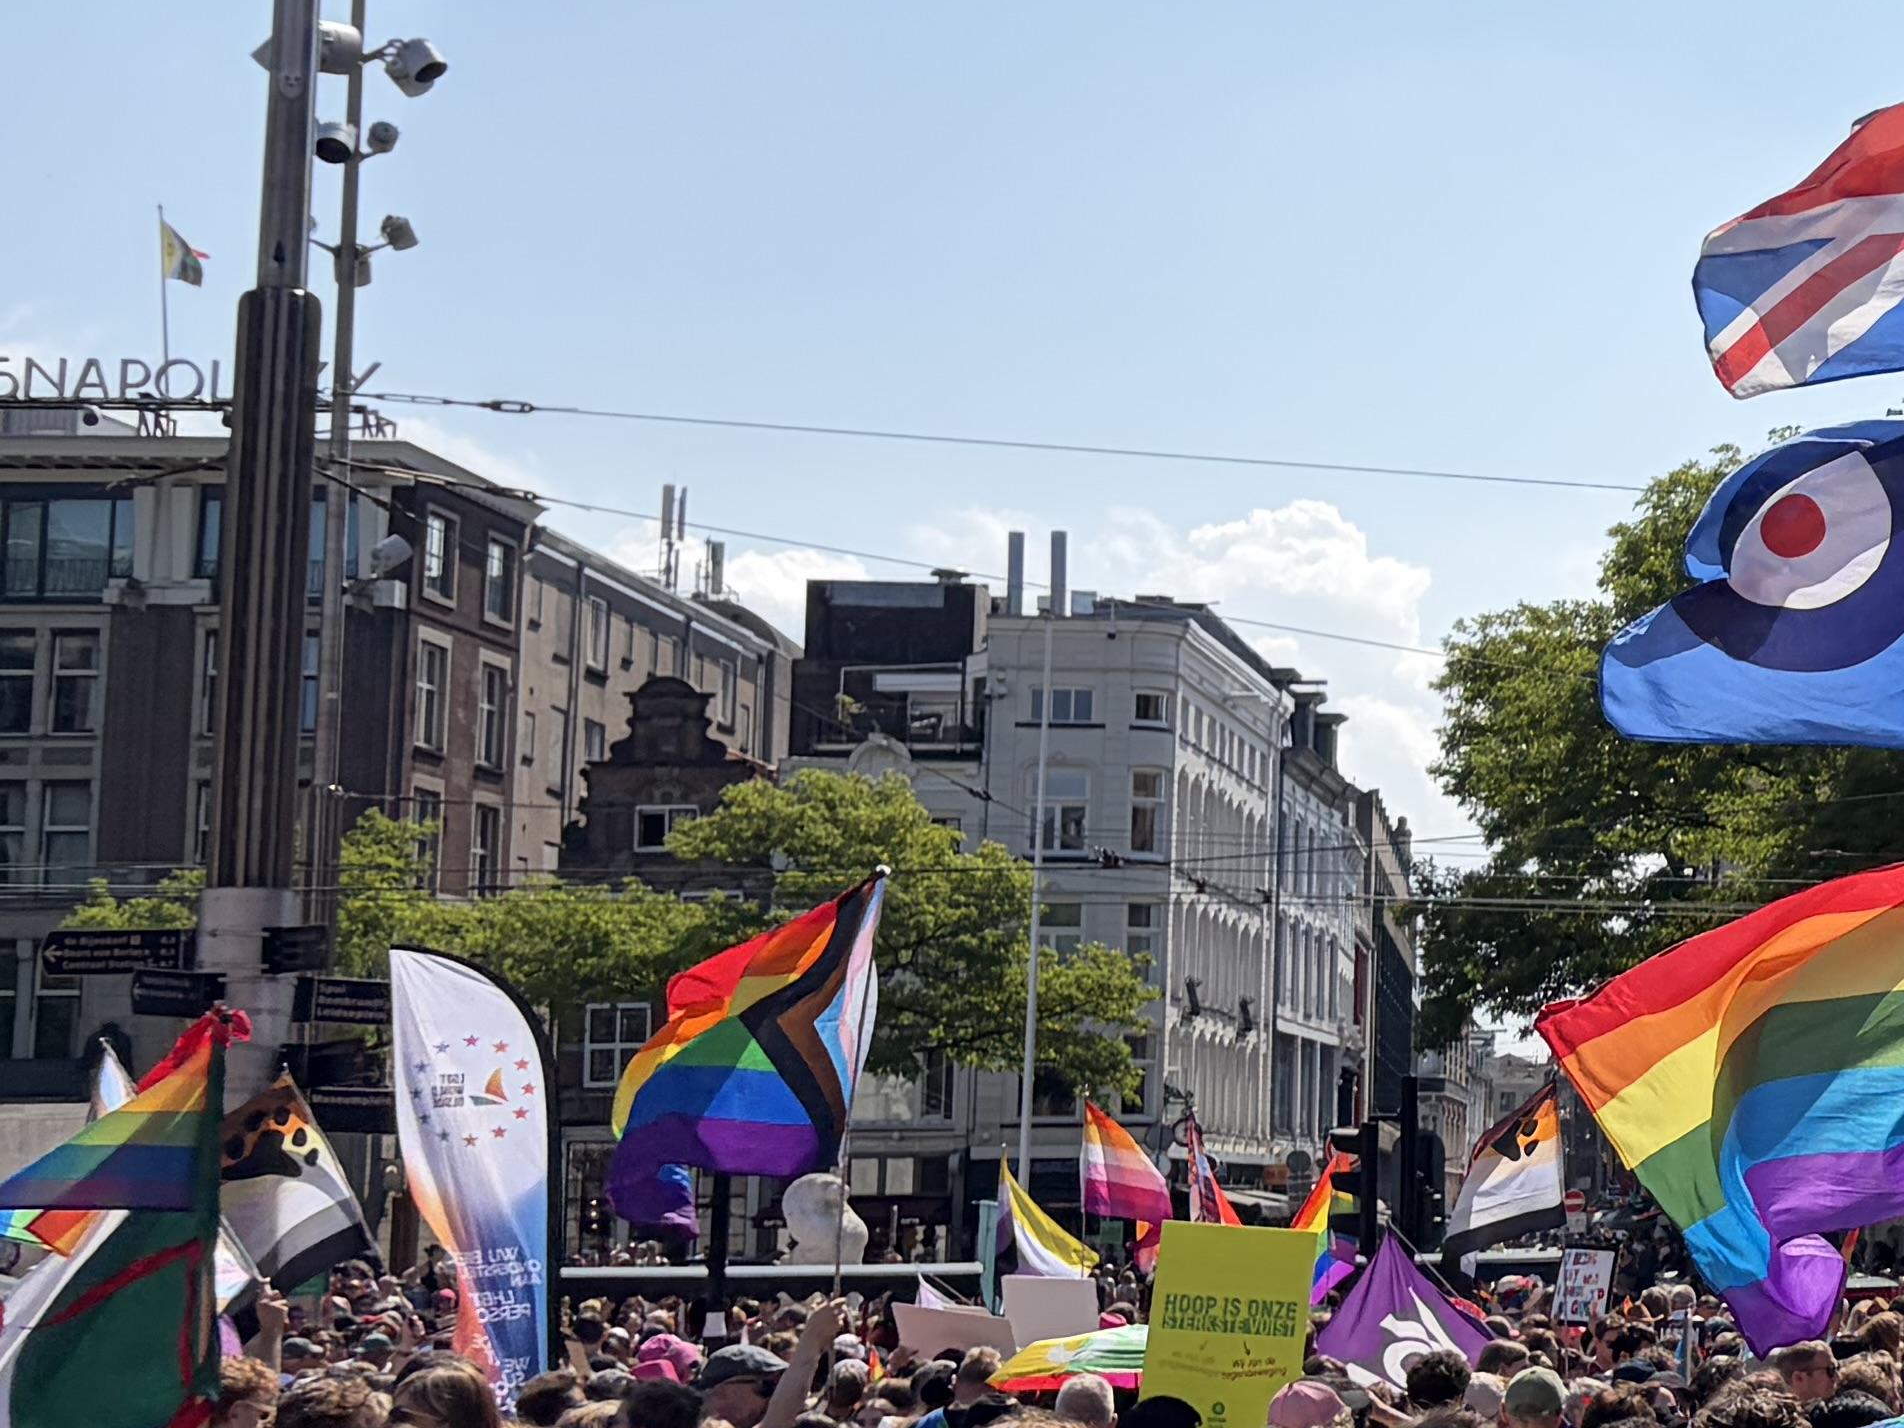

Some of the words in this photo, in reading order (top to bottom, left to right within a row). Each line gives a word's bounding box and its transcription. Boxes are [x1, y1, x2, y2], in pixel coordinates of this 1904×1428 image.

[1164, 1293, 1217, 1316] HOOP
[1223, 1297, 1242, 1317] IS
[1247, 1299, 1298, 1321] ONZE
